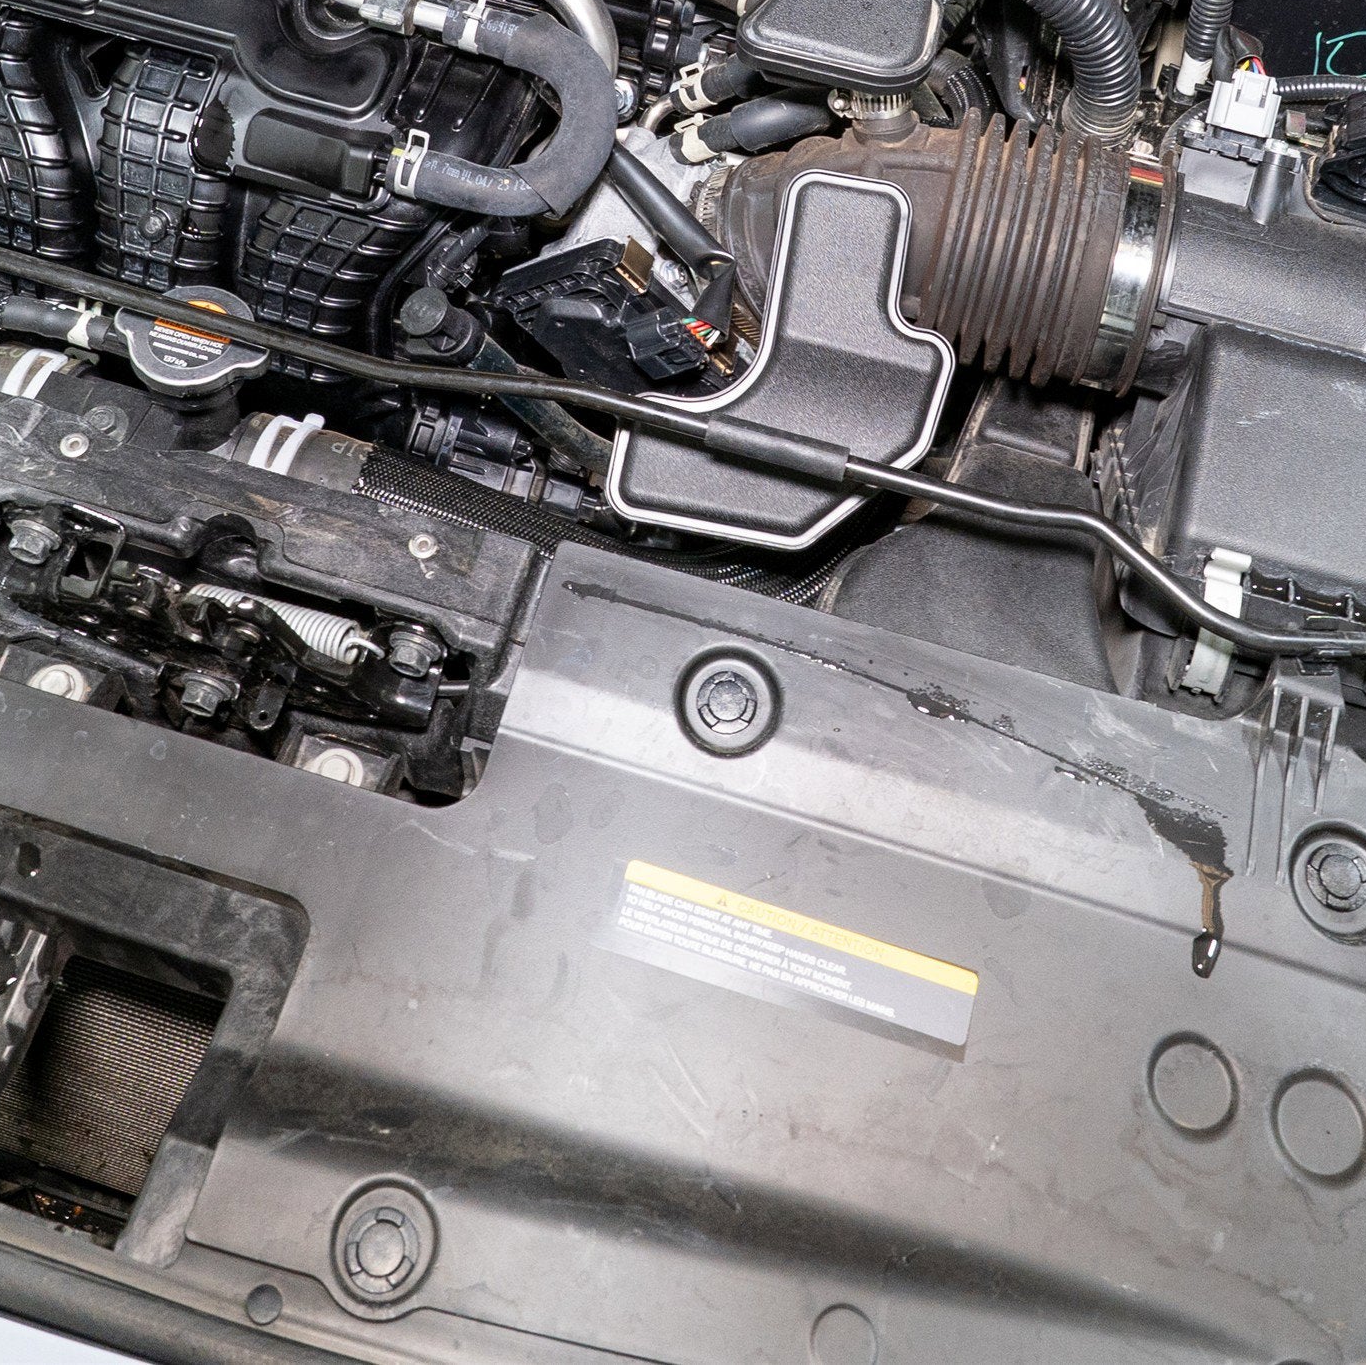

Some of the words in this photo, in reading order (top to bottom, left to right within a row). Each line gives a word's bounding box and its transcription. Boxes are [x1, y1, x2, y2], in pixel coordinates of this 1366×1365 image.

[152, 325, 174, 335] NEVER
[173, 332, 191, 340] OPEN
[190, 336, 209, 344] WHEN
[157, 333, 177, 342] JAMAIS
[623, 894, 639, 905] TO
[637, 898, 661, 913] HELP
[659, 906, 688, 922] AVOID
[685, 915, 734, 937] PERSONAL
[783, 947, 817, 965] HANDS
[814, 958, 848, 975] CLEAR.
[626, 883, 646, 896] FAN
[644, 889, 675, 905] BLADE
[672, 898, 694, 912] CAN
[692, 905, 721, 921] START
[719, 914, 732, 925] AT
[730, 918, 751, 931] ANY
[735, 901, 799, 930] CAUTION
[809, 924, 886, 958] ATTENTION
[616, 916, 645, 933] POUR
[642, 924, 674, 943] ÉVITER
[671, 935, 702, 952] TOUTE
[746, 960, 763, 973] NE
[759, 965, 781, 979] PAS
[778, 971, 794, 983] EN
[792, 976, 848, 1001] APPROCHER
[847, 994, 866, 1007] LES
[863, 1000, 897, 1018] MAINS.
[619, 905, 634, 917] LE
[631, 909, 688, 935] VENTILATEUR
[685, 927, 722, 946] RISQUE
[719, 939, 734, 951] DE
[732, 942, 782, 967] DÉMARRER
[779, 958, 791, 970] À
[788, 962, 813, 977] TOUT
[811, 970, 854, 991] MOMENT.
